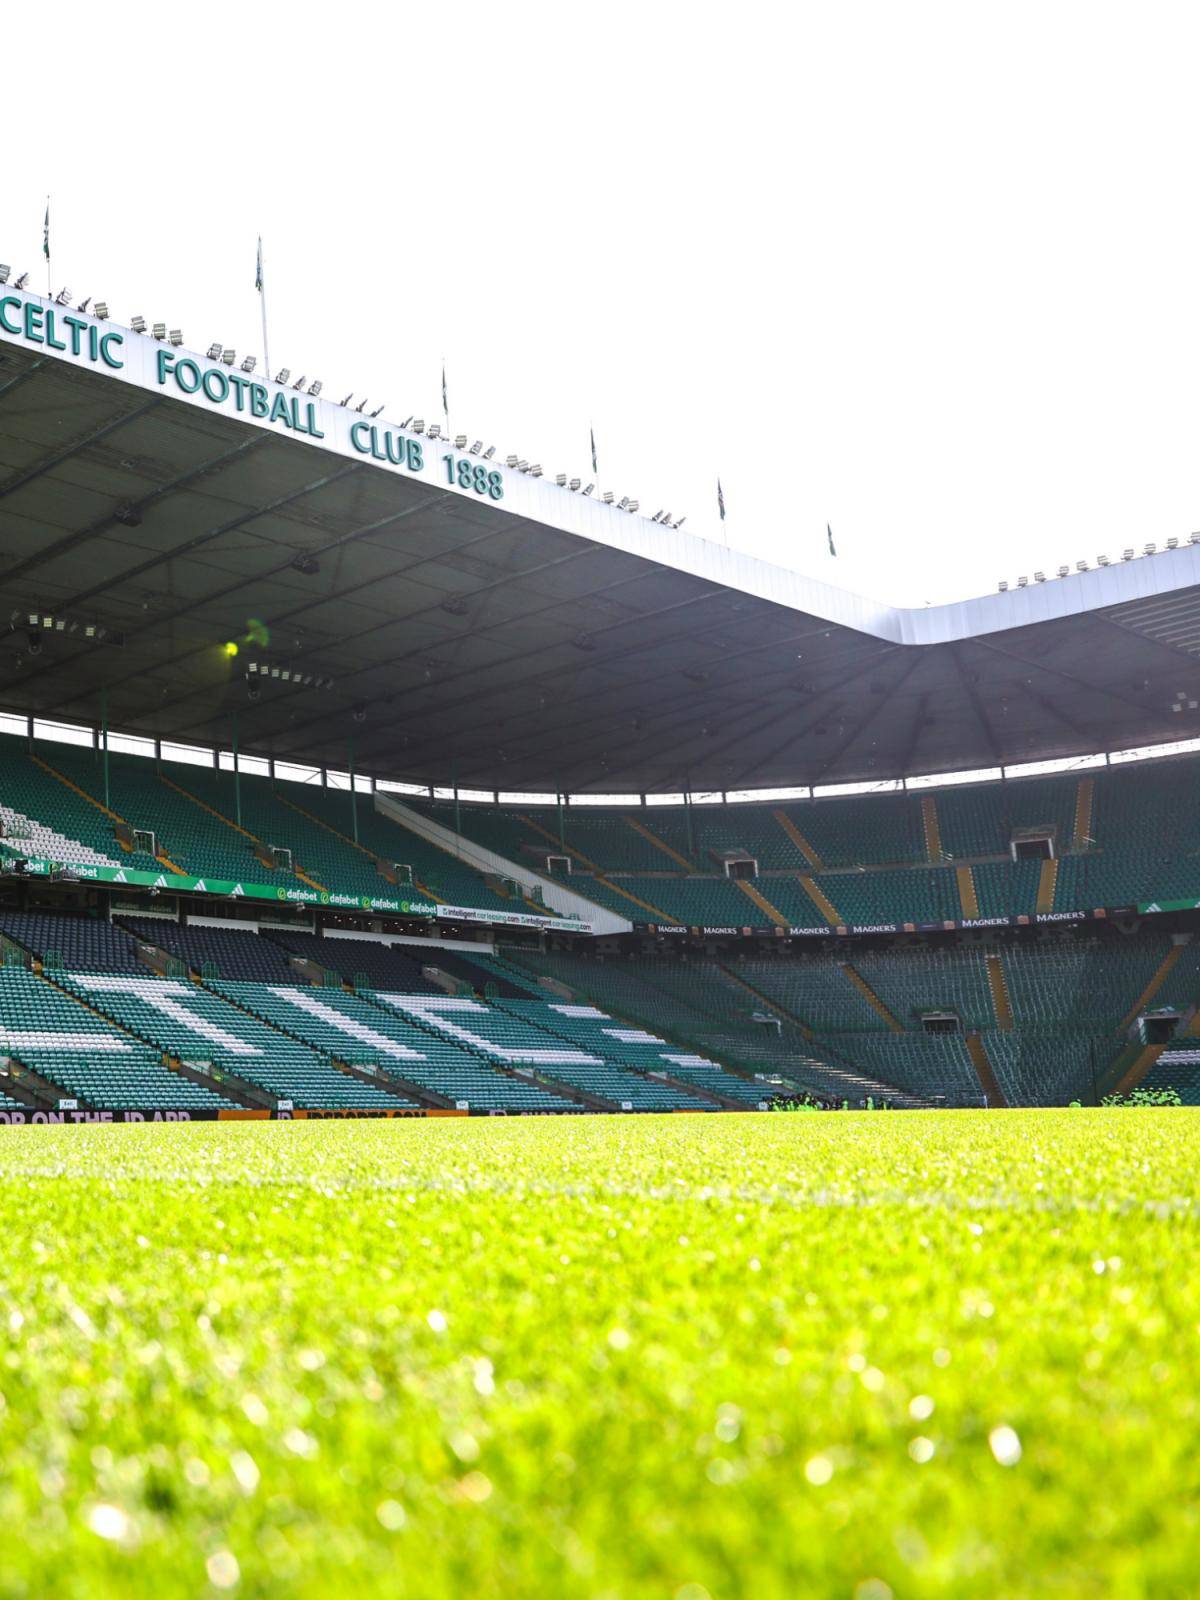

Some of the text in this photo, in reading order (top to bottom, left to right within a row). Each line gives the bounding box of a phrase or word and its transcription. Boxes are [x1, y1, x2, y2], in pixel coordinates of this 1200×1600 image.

[158, 349, 325, 439] FOOTBALL
[351, 421, 424, 472] CLUB
[443, 453, 504, 500] 1888
[286, 890, 437, 914] dafabet dafabet dafabet dafabet
[658, 911, 1086, 936] MAGNERS MAGNERS MAGNERS MAGNERS MAGNERS MAGNERS
[31, 1111, 65, 1125] ON
[70, 1111, 114, 1125] THE
